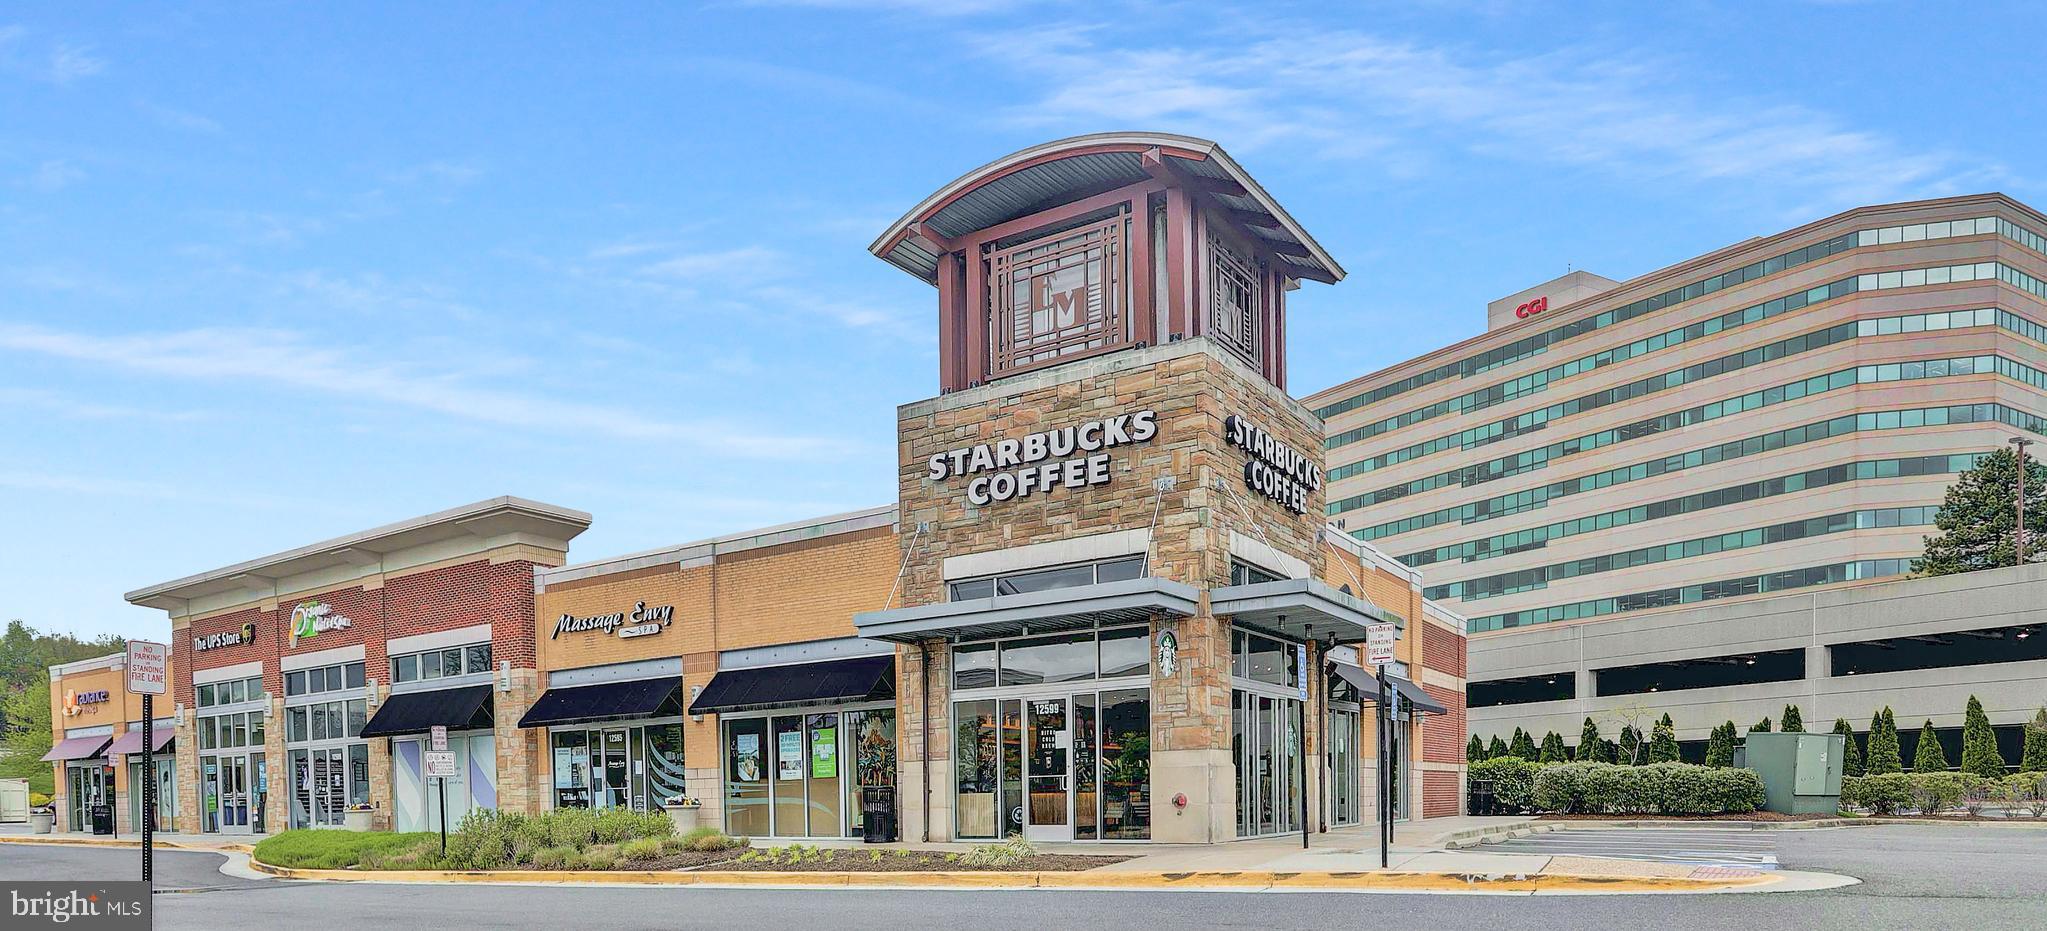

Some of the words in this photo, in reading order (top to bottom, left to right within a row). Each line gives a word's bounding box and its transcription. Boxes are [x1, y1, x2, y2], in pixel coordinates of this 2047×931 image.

[1515, 296, 1548, 319] CGI
[929, 410, 1157, 481] STARBUCKS
[1231, 414, 1321, 491] STARBUCKS
[968, 453, 1110, 505] COFFEE
[1250, 460, 1308, 514] COFFEE
[551, 613, 623, 640] Massage
[629, 600, 673, 626] Envy
[638, 626, 654, 635] SPA
[194, 637, 207, 651] The
[207, 633, 221, 649] UPS
[222, 632, 240, 646] Store
[134, 652, 162, 662] PARKING
[131, 671, 145, 681] FIRE
[147, 673, 164, 684] LANE
[132, 664, 164, 674] STANDING
[1035, 703, 1059, 715] 12599
[785, 733, 800, 742] FREE
